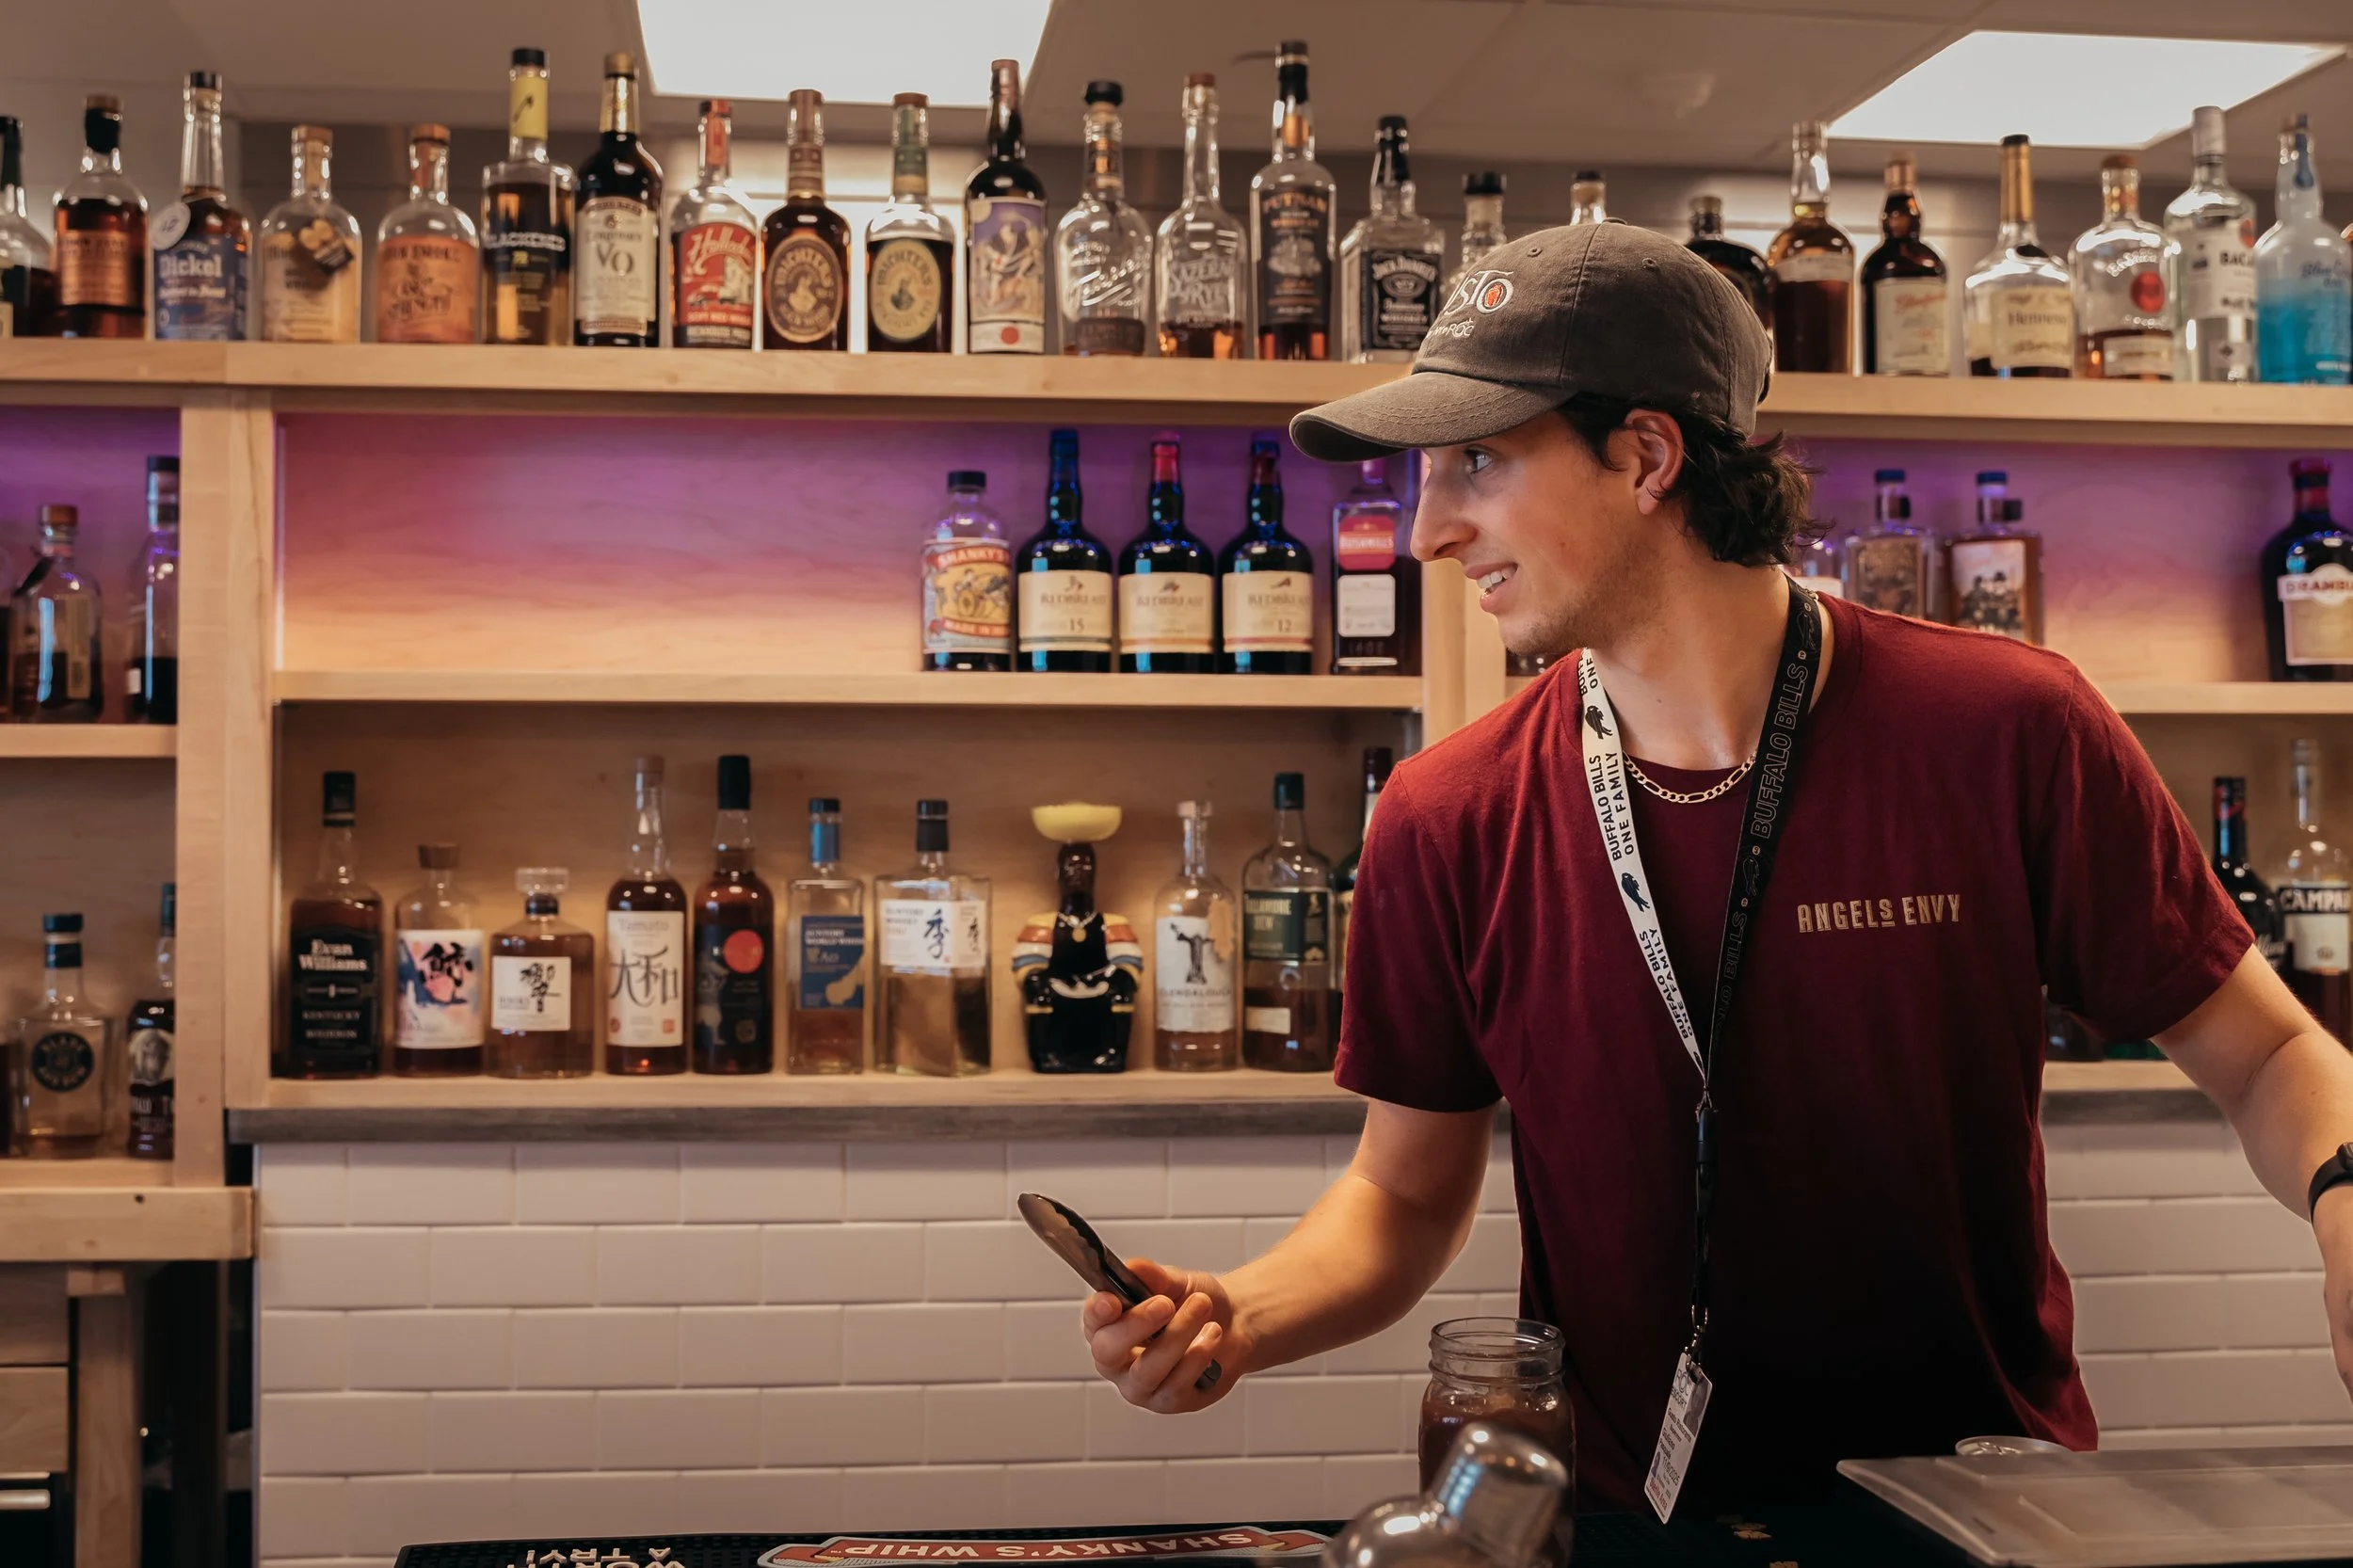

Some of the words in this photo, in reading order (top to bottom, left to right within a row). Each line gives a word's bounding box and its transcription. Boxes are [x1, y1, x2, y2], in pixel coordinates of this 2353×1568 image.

[1069, 617, 1085, 632] 15
[1277, 619, 1292, 632] 12
[1750, 732, 1792, 839] BUFFALO
[1773, 663, 1808, 730] BILLS
[1589, 755, 1607, 794] BILLS
[1605, 752, 1626, 813] FAMILY
[1597, 795, 1623, 861] BUFFALO
[1619, 818, 1635, 856] ONE
[1797, 898, 1896, 933] ANGELS
[1901, 894, 1961, 926] ENVY
[298, 953, 368, 971] Williams
[312, 939, 354, 955] Evan
[1639, 930, 1661, 972] BILLS
[1649, 927, 1678, 994] FAMILY
[1723, 910, 1748, 980] BILLS
[1657, 974, 1690, 1040] BUFFALO
[1677, 1000, 1693, 1036] ONE
[525, 1548, 631, 1564] TRY!
[648, 1547, 671, 1562] A
[844, 1544, 980, 1558] WHIP
[995, 1533, 1253, 1558] SHANKY'S
